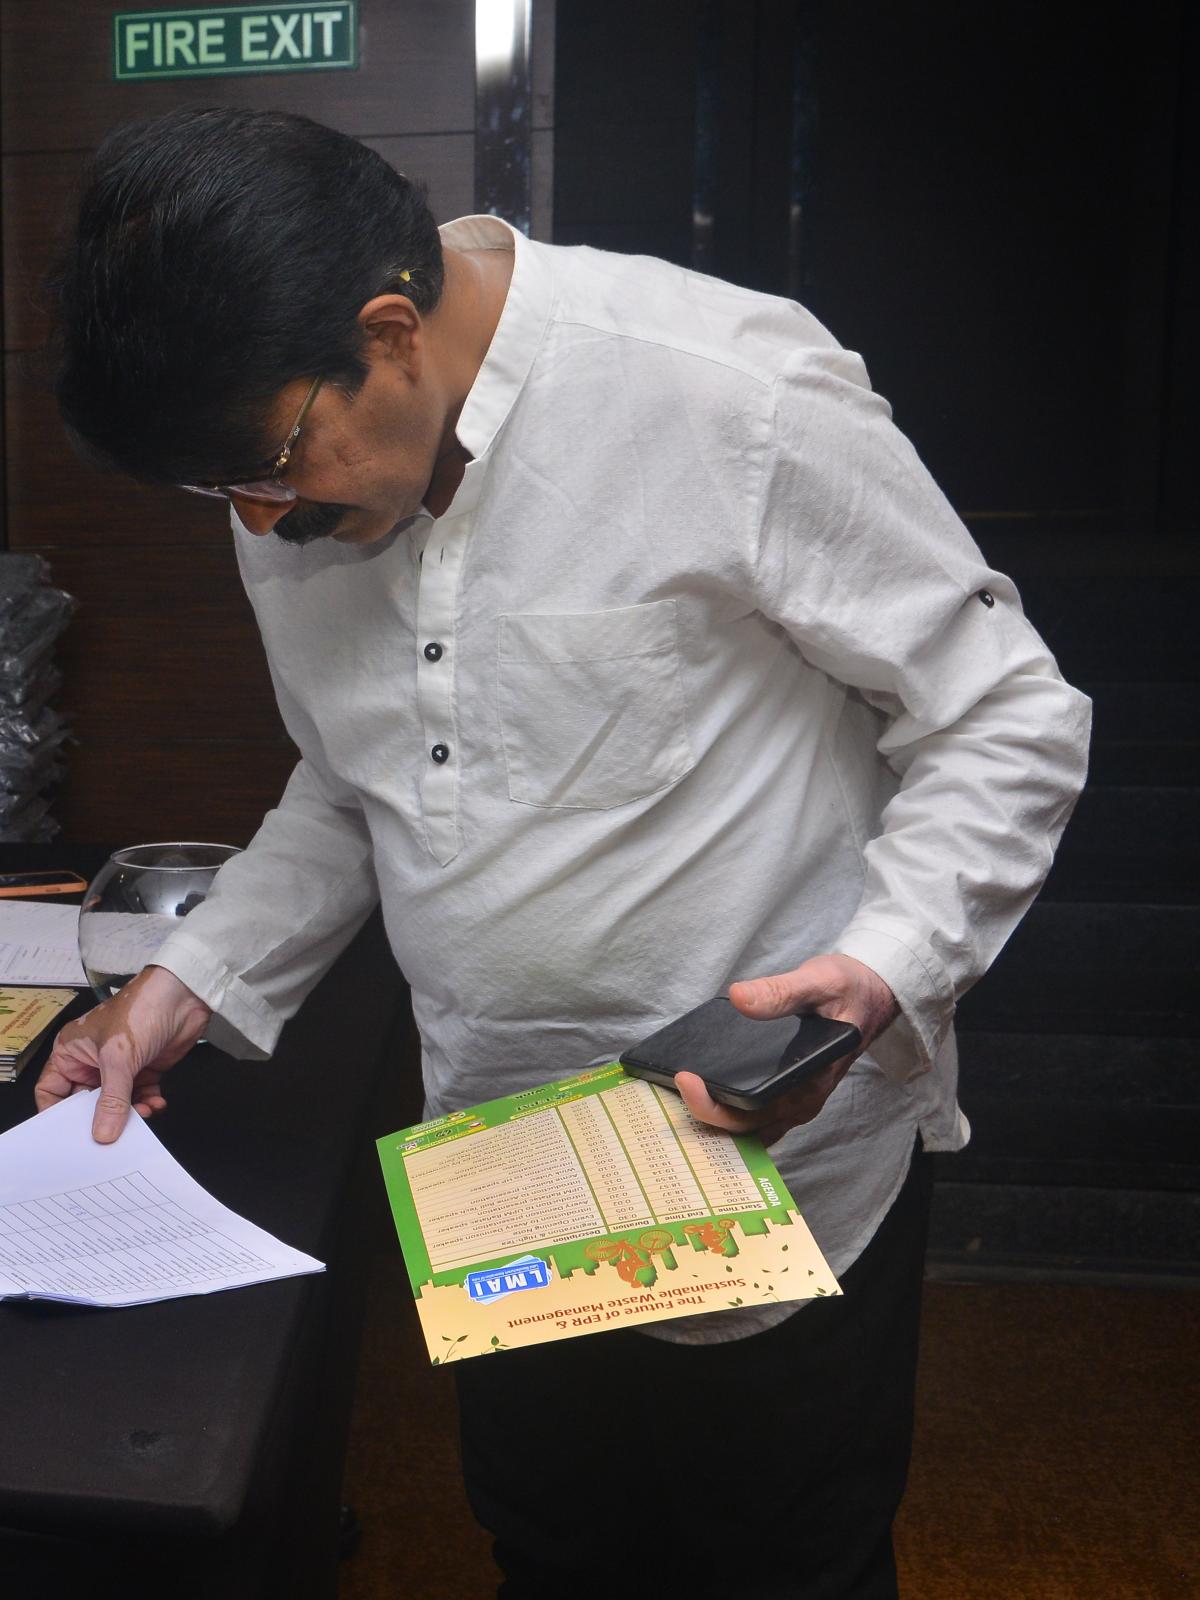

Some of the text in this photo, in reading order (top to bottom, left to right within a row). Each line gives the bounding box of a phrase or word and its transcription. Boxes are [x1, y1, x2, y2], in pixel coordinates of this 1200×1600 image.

[126, 11, 342, 68] FIRE EXIT
[639, 1139, 662, 1148] 19:33
[698, 1139, 721, 1147] 19:26
[589, 1145, 607, 1153] 0:10
[642, 1146, 665, 1155] 19:31
[701, 1145, 725, 1153] 19:16
[591, 1151, 610, 1159] 0:02
[645, 1153, 668, 1161] 19:26
[705, 1152, 728, 1160] 19:14
[594, 1157, 612, 1165] 0:05
[648, 1160, 671, 1169] 19:16
[708, 1159, 732, 1167] 18:59
[507, 1158, 557, 1175] presentation
[524, 1160, 573, 1177] Introduction
[651, 1167, 674, 1175] 19:14
[712, 1166, 735, 1174] 18:57
[529, 1172, 552, 1182] Video
[554, 1172, 577, 1182] Acme
[602, 1177, 621, 1185] 0:15
[654, 1174, 678, 1182] 18:59
[470, 1181, 498, 1192] speaker
[531, 1178, 580, 1195] Introduction
[562, 1185, 583, 1194] UPM
[605, 1184, 624, 1192] 0:02
[657, 1181, 681, 1189] 18:57
[608, 1191, 627, 1199] 0:20
[660, 1189, 684, 1197] 18:37
[722, 1188, 746, 1196] 18:30
[758, 1176, 781, 1206] AGENDA
[469, 1188, 519, 1205] presentation
[496, 1195, 519, 1205] Acme
[536, 1192, 585, 1208] Introduction
[664, 1196, 688, 1204] 18:35
[725, 1195, 750, 1203] 18:00
[477, 1199, 527, 1216] presentation
[667, 1203, 691, 1211] 18:30
[428, 1211, 458, 1223] speaker
[472, 1199, 588, 1231] Avery Dennison presentation
[503, 1208, 523, 1217] UPM
[540, 1206, 591, 1222] Introduction
[663, 1213, 685, 1221] Time
[437, 1222, 467, 1233] speaker
[505, 1221, 528, 1231] Avery
[512, 1213, 594, 1236] Event Opening Note
[547, 1220, 596, 1235] Registration
[612, 1219, 649, 1230] Duration
[465, 1227, 503, 1240] Dennison
[552, 1228, 600, 1243] Description
[432, 1237, 463, 1248] speaker
[474, 1268, 543, 1295] LMAI
[506, 1276, 746, 1329] Sustainable Waste Management
[555, 1294, 705, 1329] The Future of EPR &
